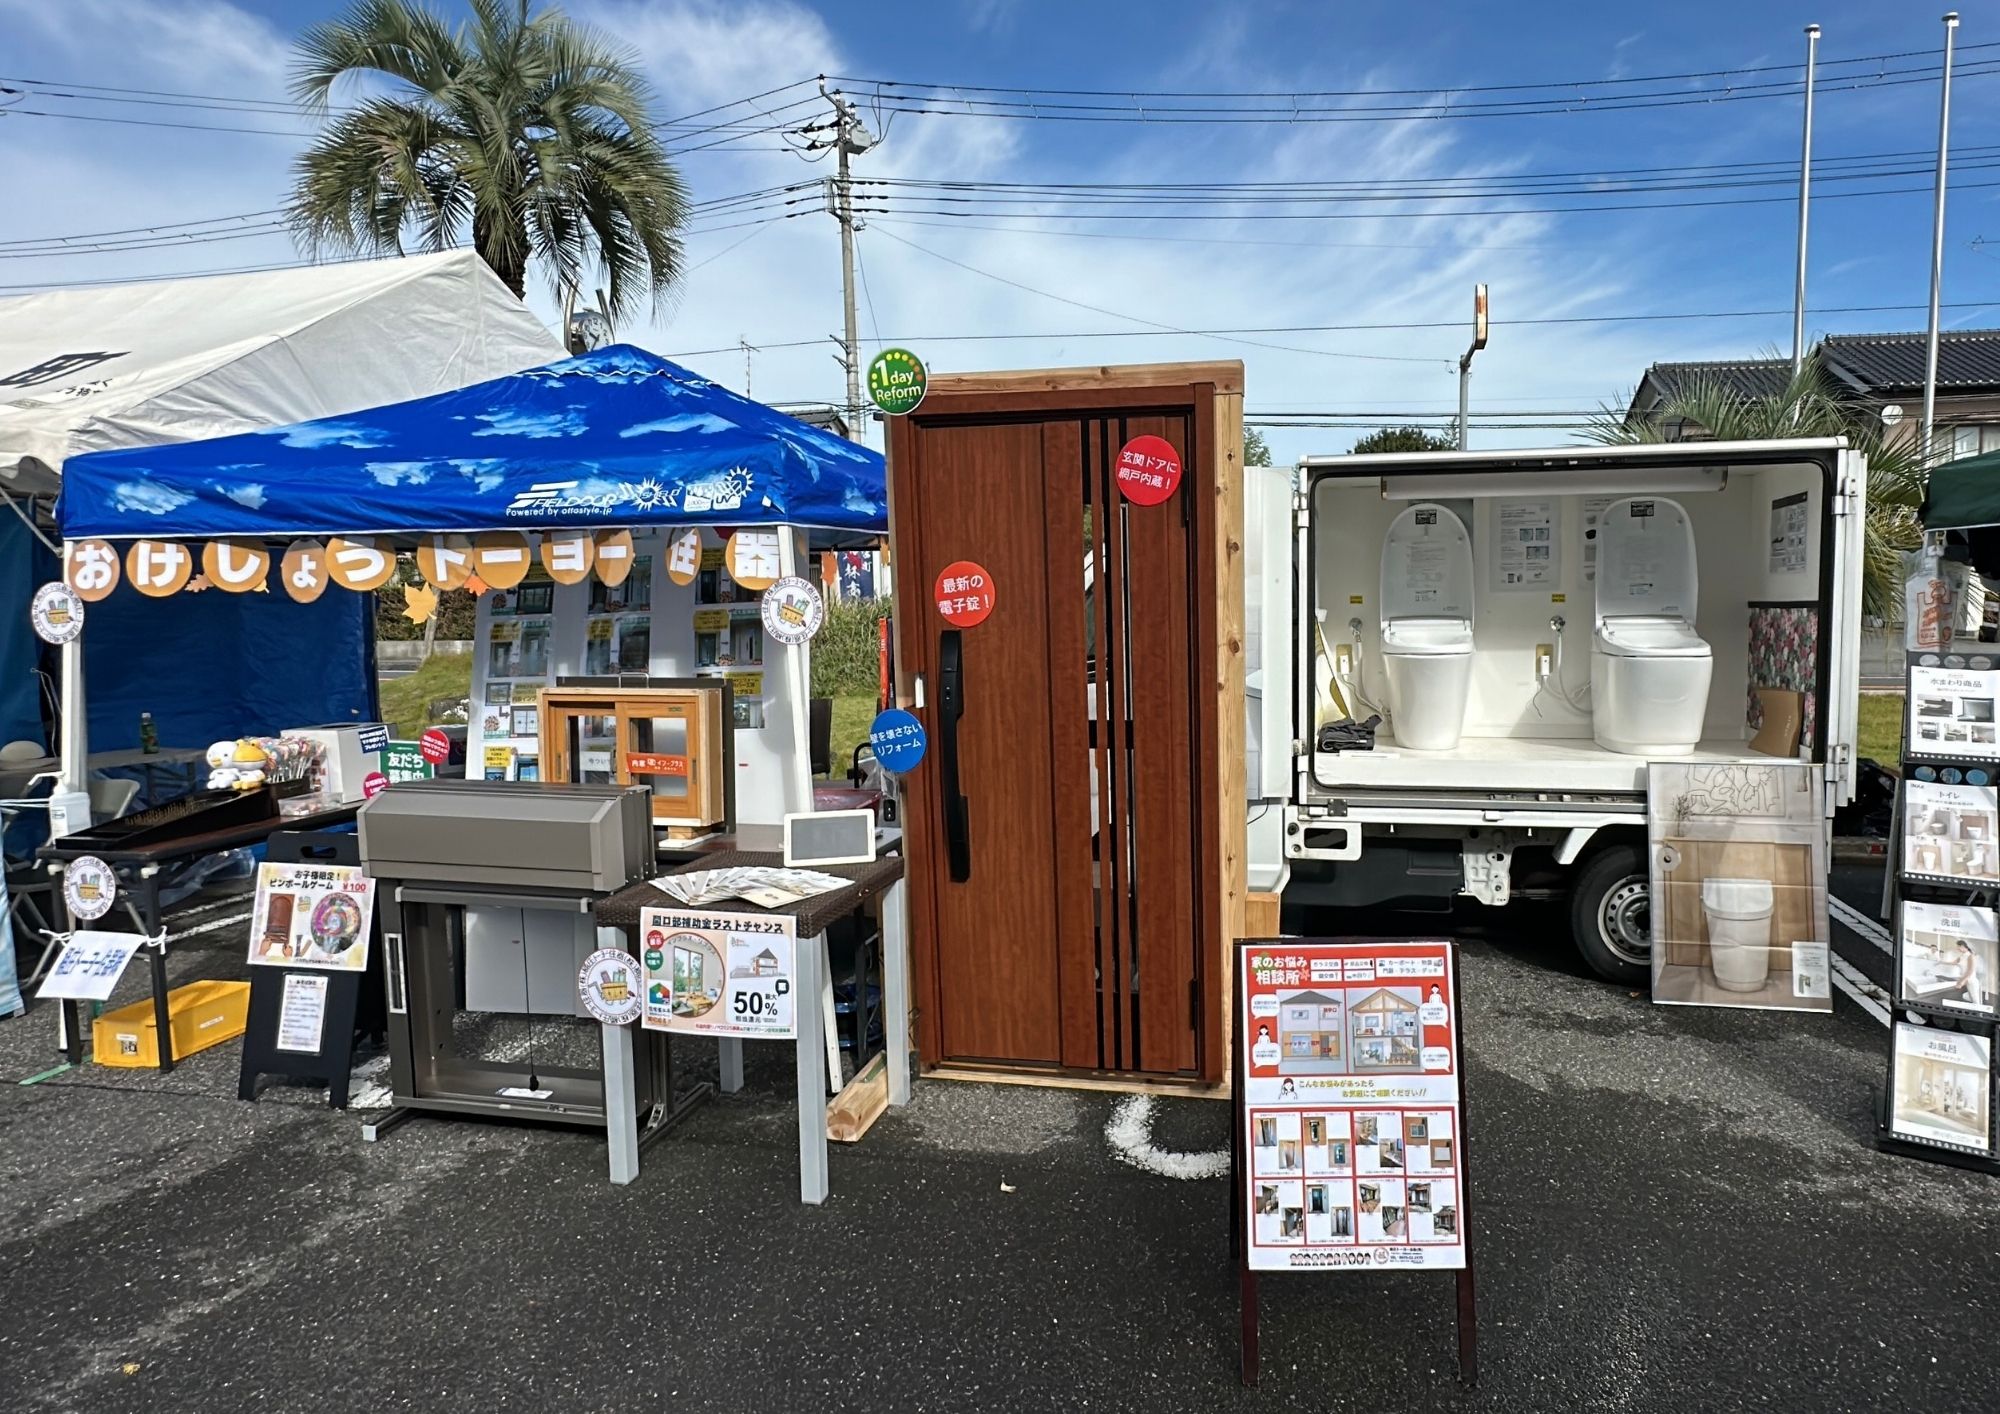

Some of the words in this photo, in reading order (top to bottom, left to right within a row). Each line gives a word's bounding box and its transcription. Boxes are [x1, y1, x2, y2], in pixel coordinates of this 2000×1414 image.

[875, 360, 889, 386] 1
[890, 370, 914, 385] day
[876, 386, 921, 402] Reform
[1122, 450, 1178, 473] 玄関ドアに
[506, 508, 545, 517] Powered
[547, 508, 559, 517] by
[943, 575, 984, 594] 最新の
[1931, 679, 1982, 688] 水まわり商品
[870, 723, 922, 744] 壁を壊さない
[877, 738, 922, 756] リフォーム
[388, 752, 424, 768] 友だち
[1940, 791, 1960, 799] トイレ
[269, 879, 334, 890] ピンボールゲーム
[652, 914, 784, 933] 開口部補助金ラストチャンス
[1251, 956, 1308, 968] 家のお悩み
[1256, 969, 1300, 985] 相談所
[1918, 1041, 1957, 1054] お風呂
[1299, 1080, 1375, 1088] こんなお悩みがあったら
